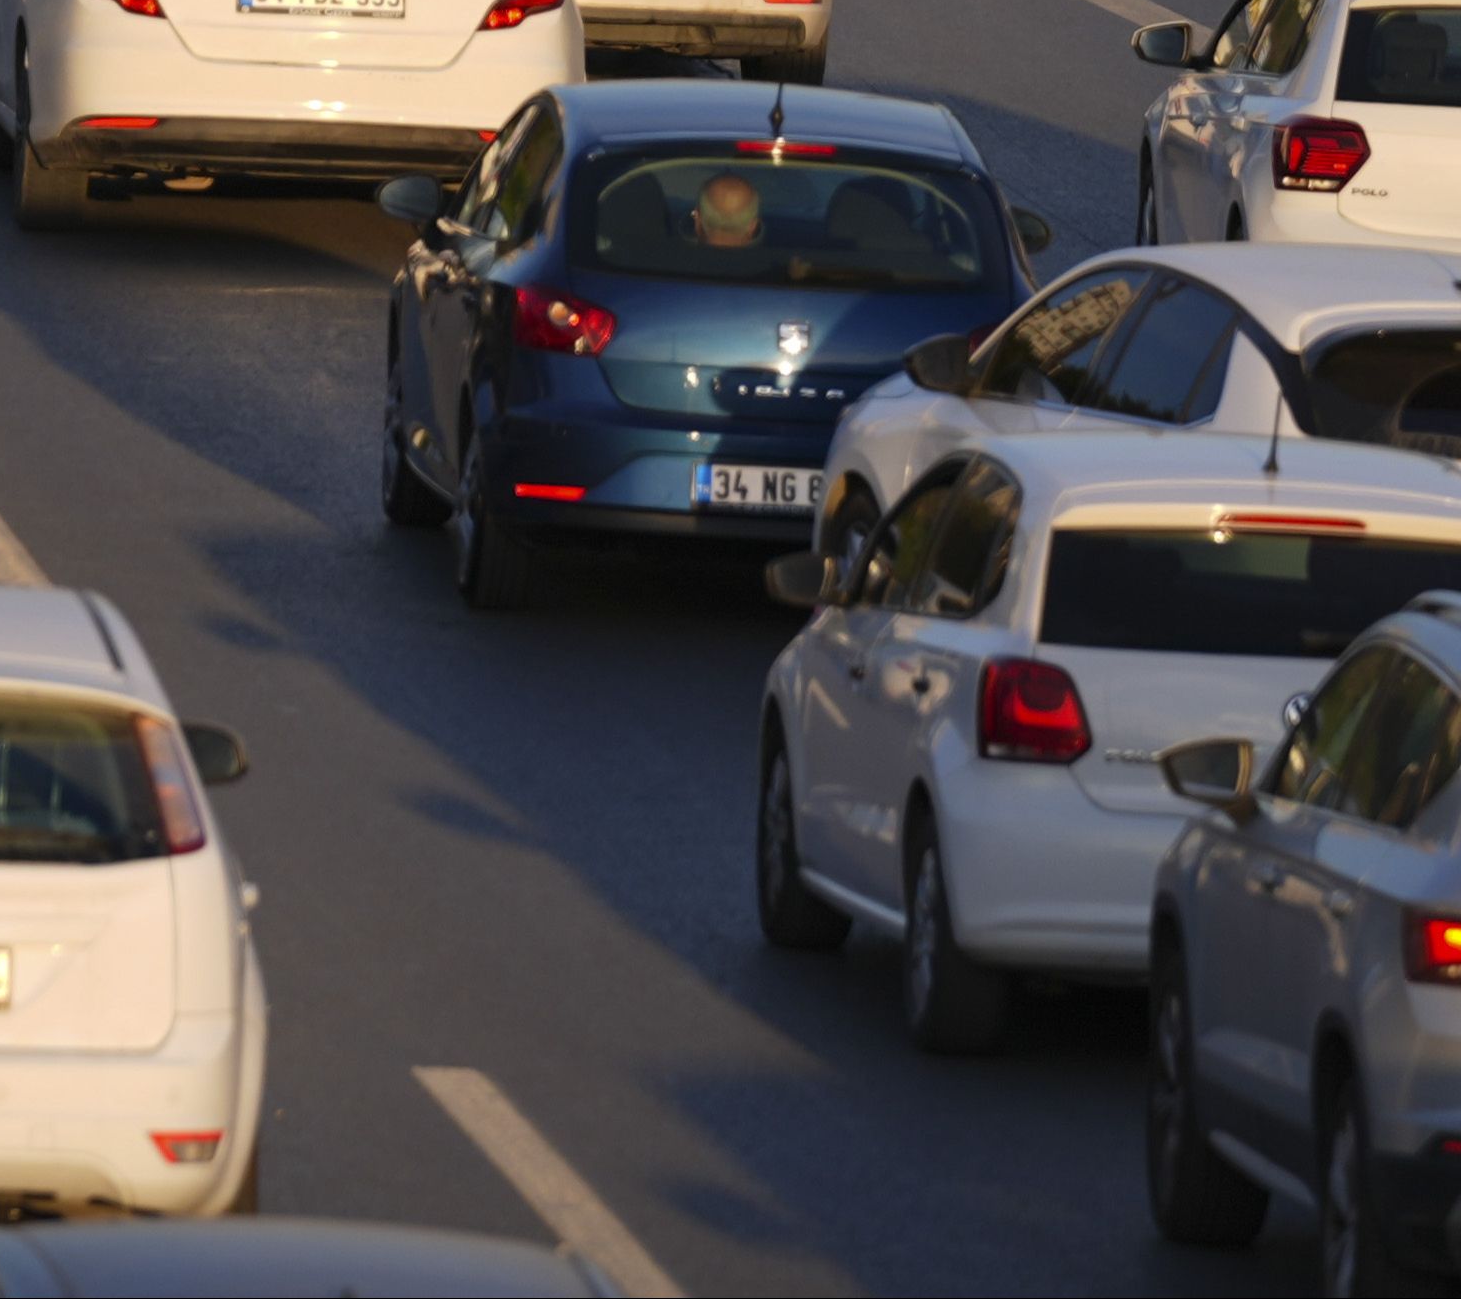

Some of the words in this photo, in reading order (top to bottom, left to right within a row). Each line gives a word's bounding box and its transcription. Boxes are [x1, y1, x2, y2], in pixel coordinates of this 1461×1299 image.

[1352, 187, 1388, 197] POLO
[714, 470, 748, 502] 34
[761, 472, 796, 504] NG
